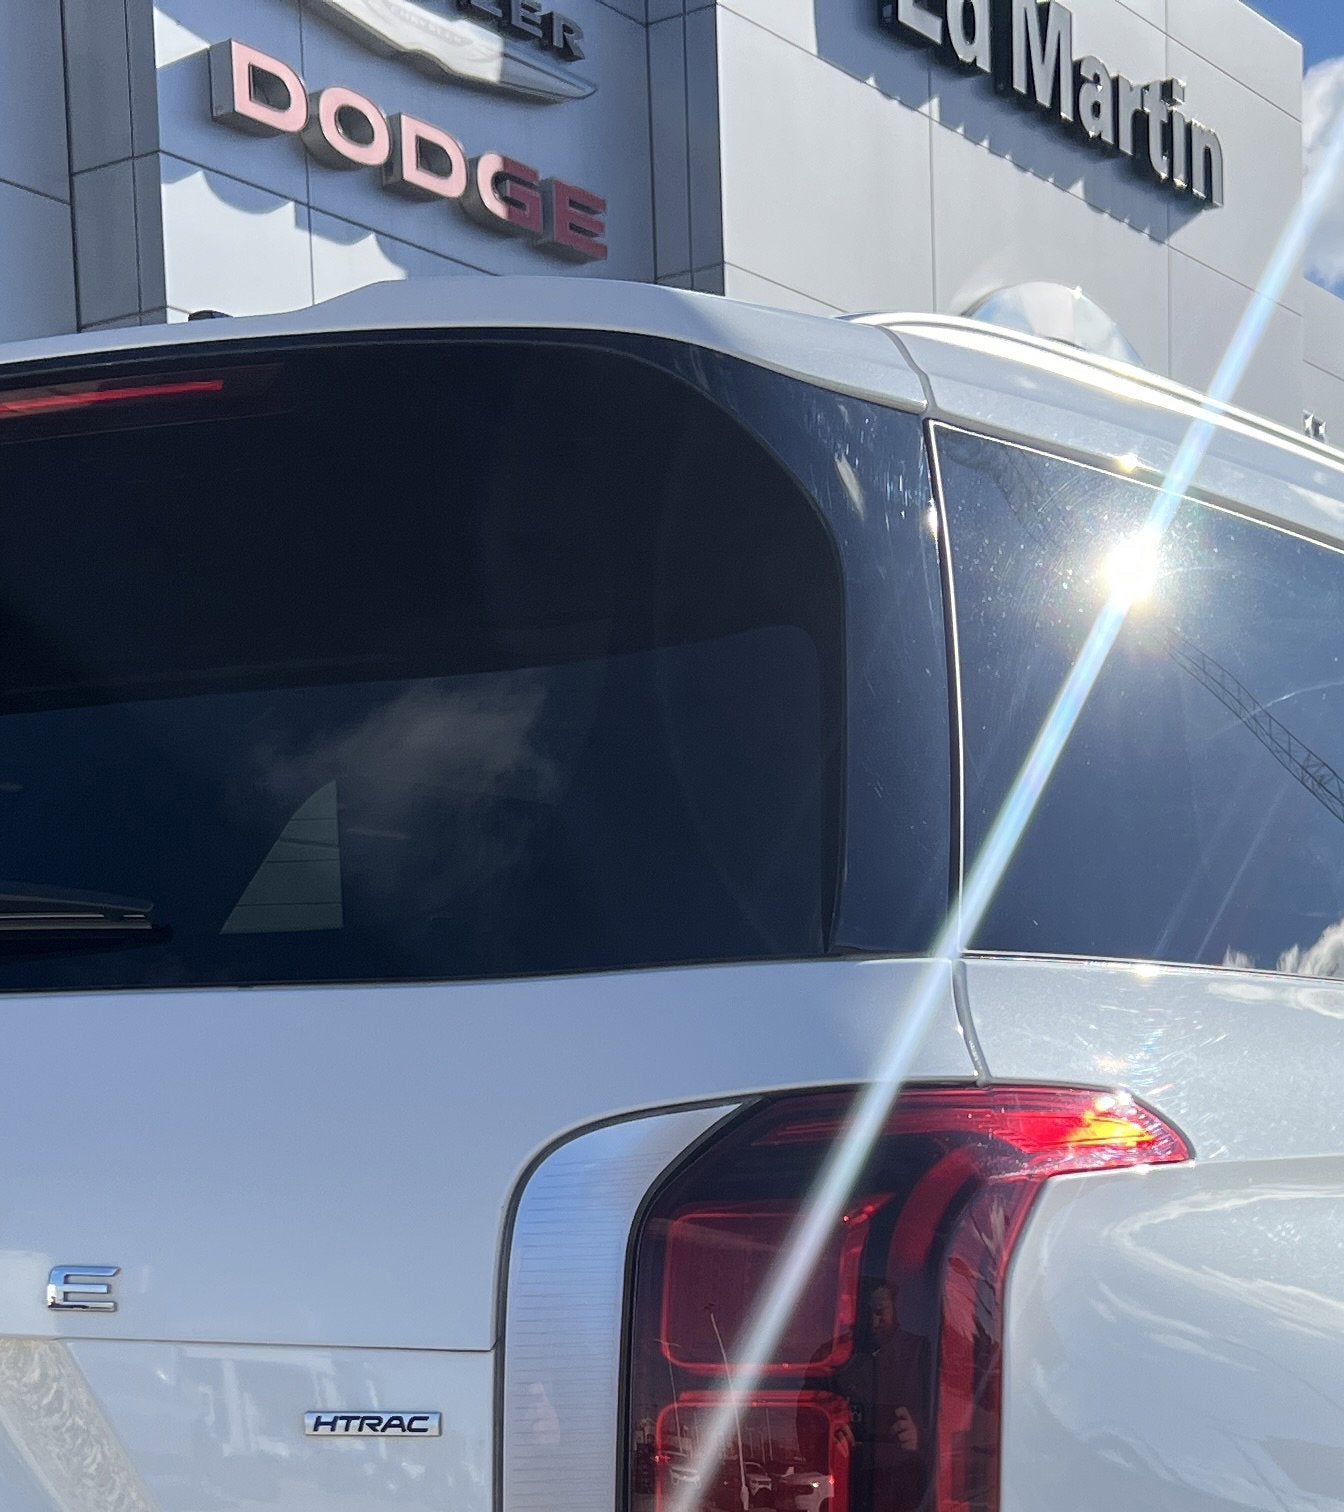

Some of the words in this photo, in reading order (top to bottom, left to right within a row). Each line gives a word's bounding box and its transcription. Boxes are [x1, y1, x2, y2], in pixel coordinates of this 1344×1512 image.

[221, 38, 609, 261] DODGE
[1011, 0, 1225, 208] Martin
[312, 1414, 430, 1434] HTRAC
